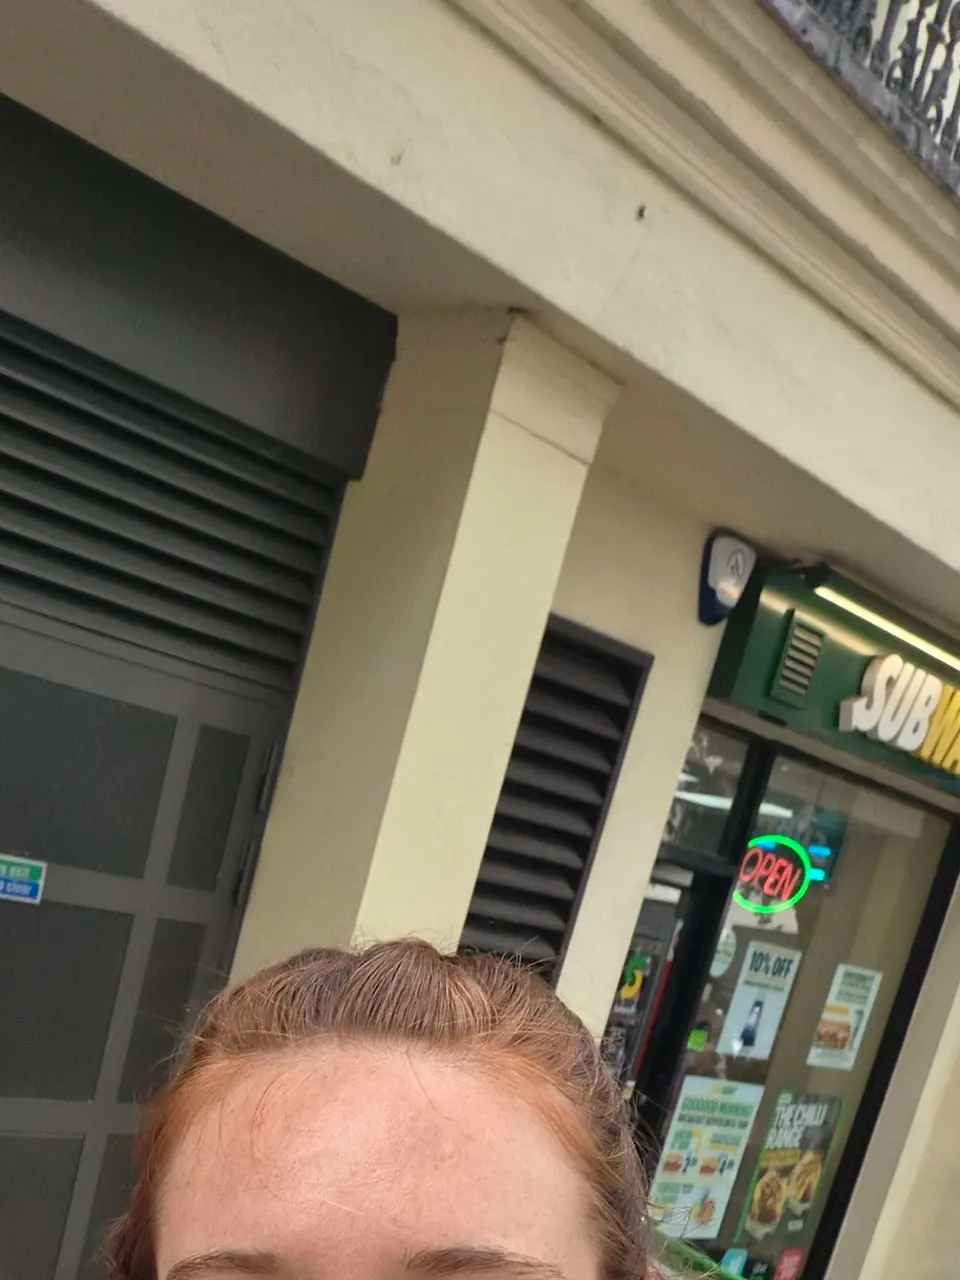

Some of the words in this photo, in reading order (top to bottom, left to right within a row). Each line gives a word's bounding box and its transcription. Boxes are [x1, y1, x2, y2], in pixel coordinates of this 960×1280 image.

[739, 847, 802, 902] OPEN
[750, 950, 771, 976] 10%
[771, 956, 794, 980] OFF
[772, 1104, 798, 1128] THE
[765, 1126, 803, 1150] RANGE
